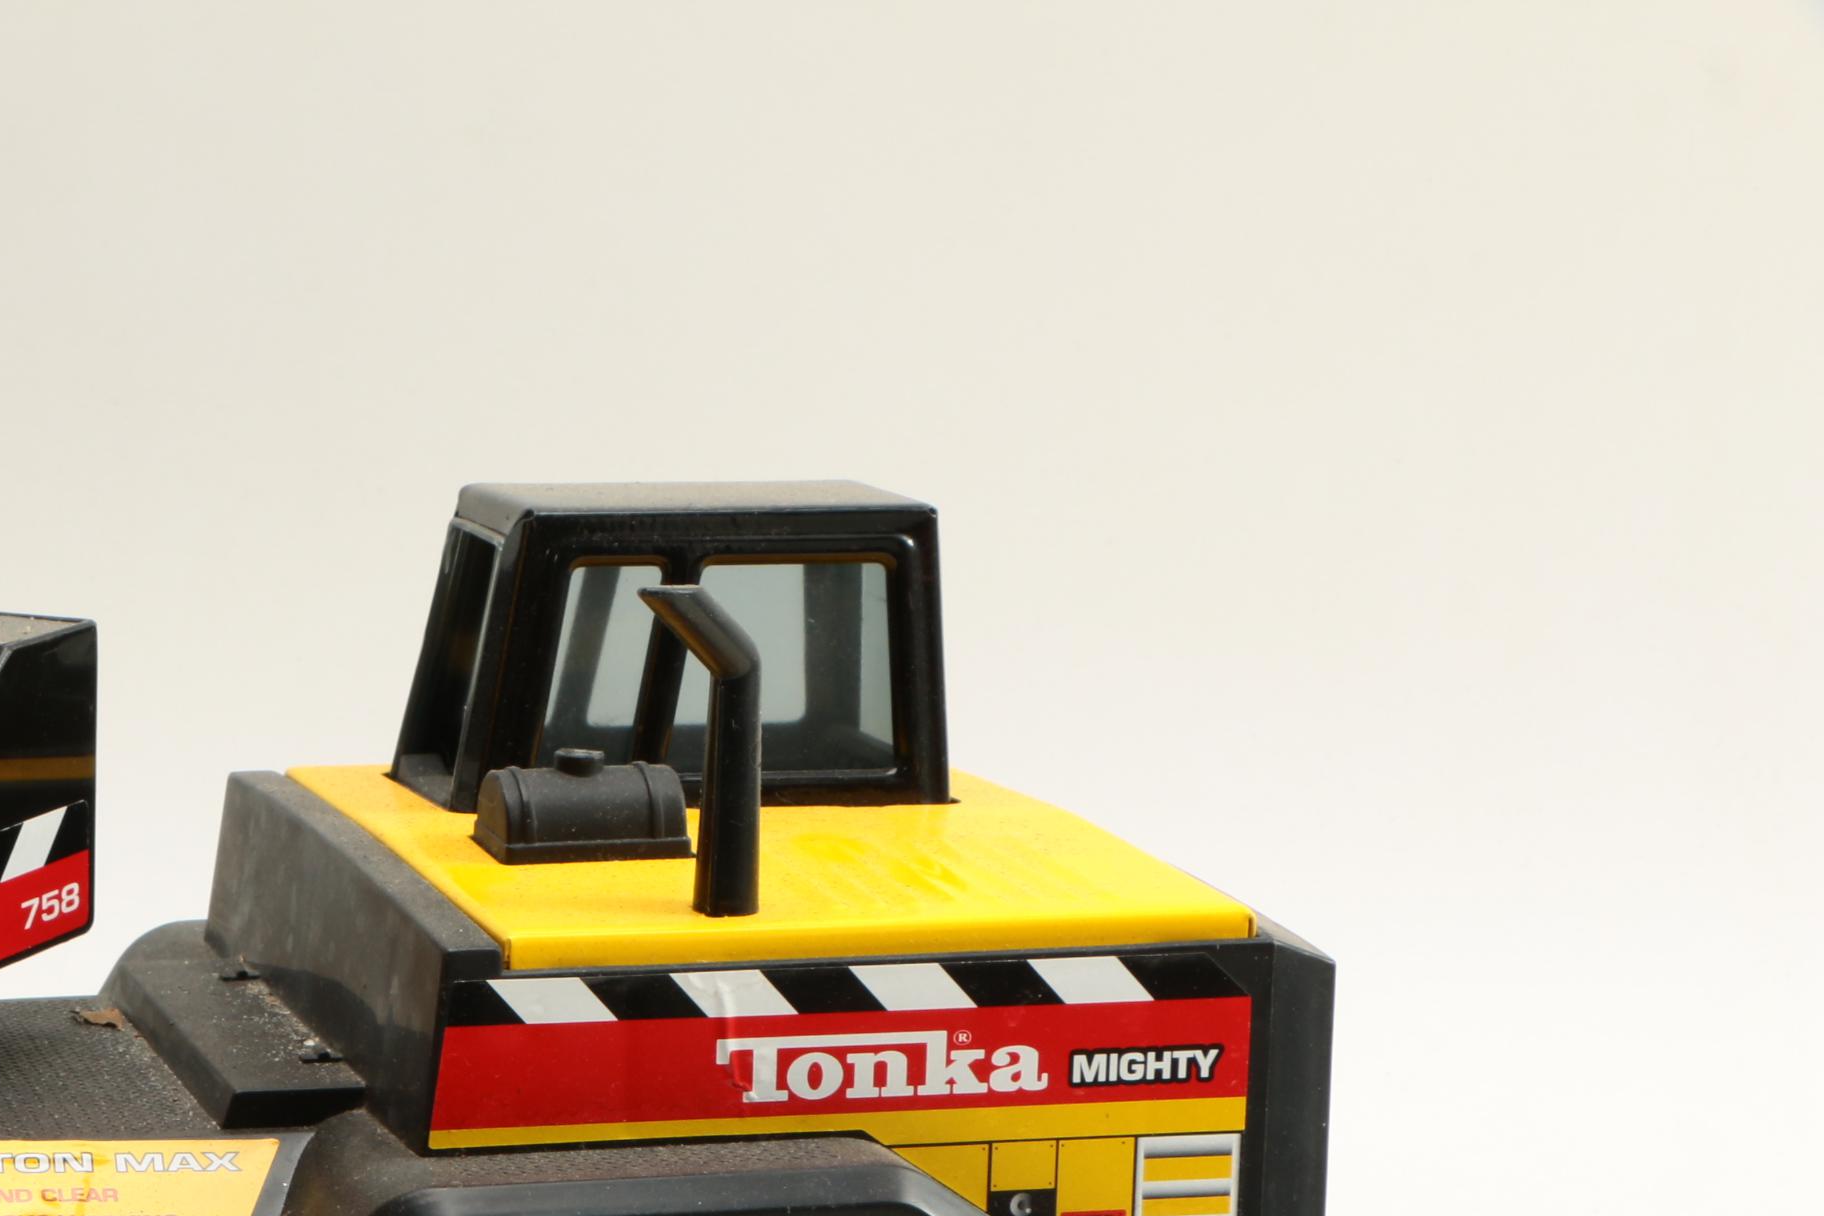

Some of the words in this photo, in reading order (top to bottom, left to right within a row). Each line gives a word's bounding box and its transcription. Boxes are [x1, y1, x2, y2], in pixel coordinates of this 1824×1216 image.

[20, 881, 81, 930] 758
[1071, 1047, 1220, 1085] MIGHTY
[113, 1150, 242, 1174] MAX
[40, 1186, 119, 1203] CLEAR
